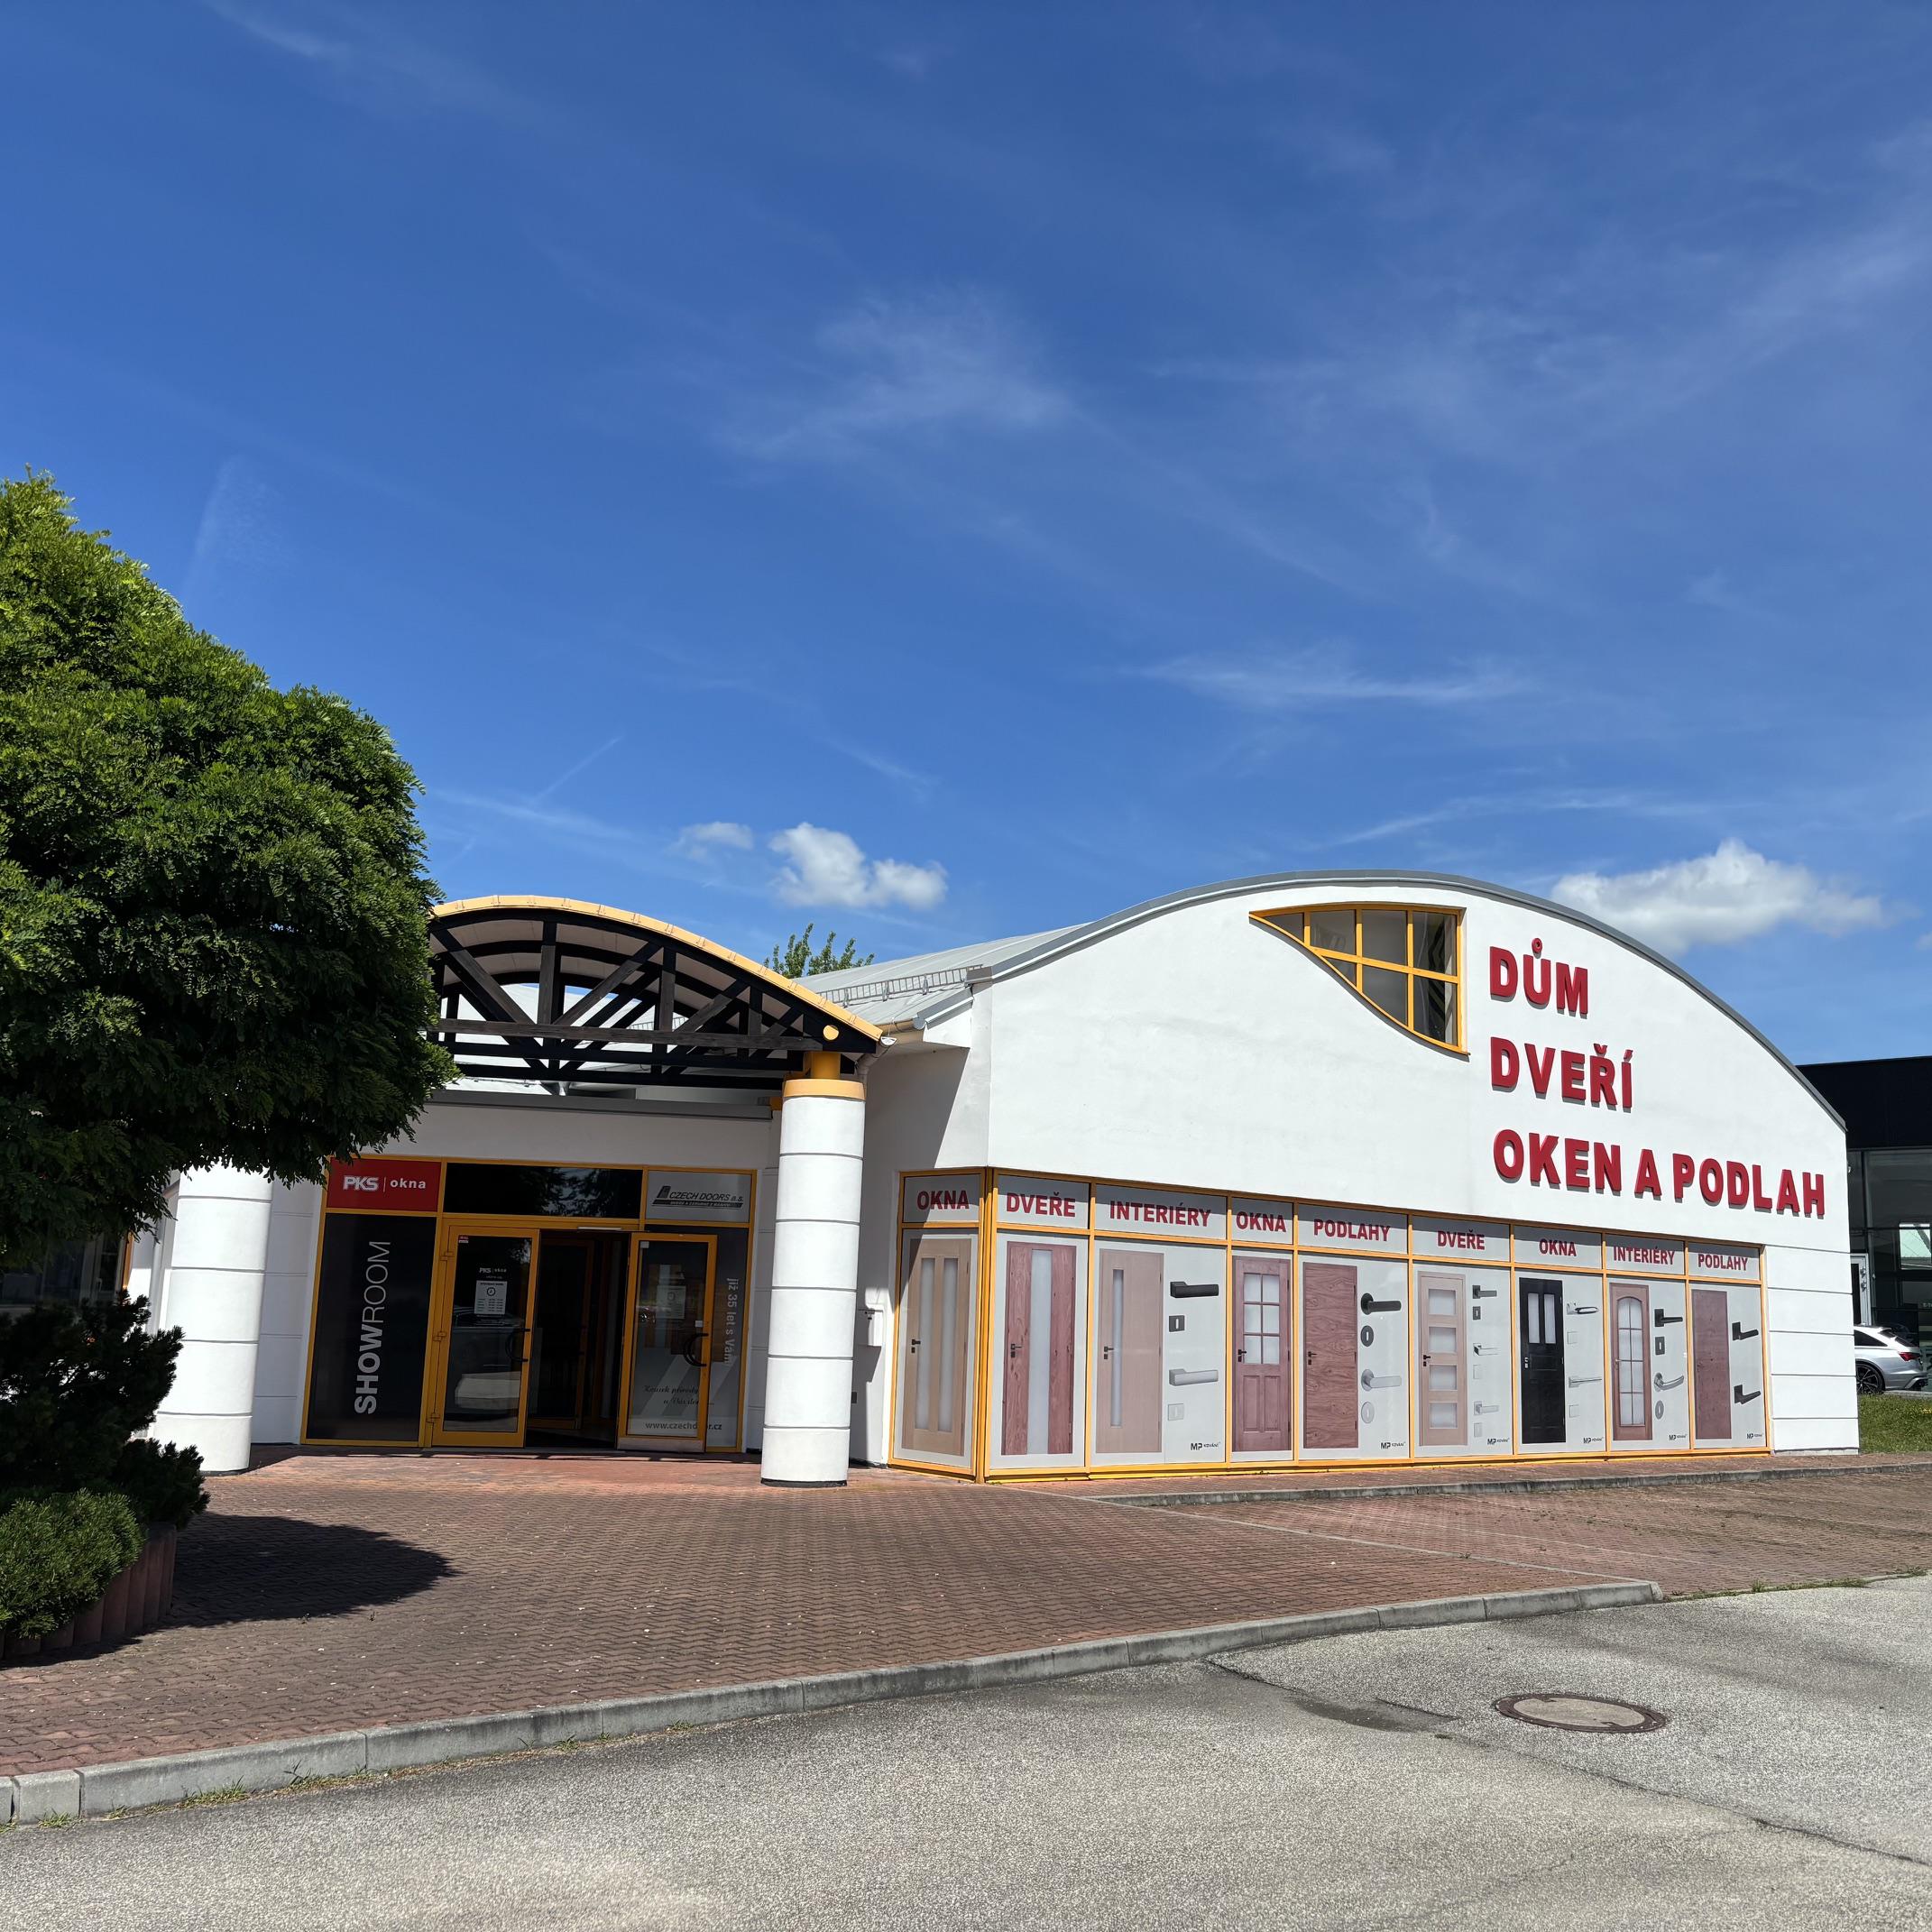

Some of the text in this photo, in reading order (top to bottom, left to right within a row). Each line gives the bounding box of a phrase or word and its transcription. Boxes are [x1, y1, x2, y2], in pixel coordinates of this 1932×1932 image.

[1489, 937, 1588, 1017] DŮM
[1490, 1036, 1633, 1109] DVEŘÍ
[1493, 1129, 1826, 1217] OKEN A PODLAH
[343, 1176, 427, 1191] PKS okna
[668, 1191, 699, 1200] CZECH
[699, 1192, 731, 1201] DOORS
[917, 1190, 970, 1210] OKNA
[1006, 1192, 1076, 1218] DVEŘE
[1109, 1201, 1210, 1228] INTERIÉRY
[1236, 1211, 1286, 1233] OKNA
[1313, 1219, 1391, 1243] PODLAHY
[1437, 1229, 1486, 1251] DVEŘE
[1539, 1238, 1578, 1257] OKNA
[1613, 1245, 1675, 1265] INTERIÉRY
[1697, 1254, 1748, 1271] PODLAHY
[726, 1277, 739, 1291] již
[727, 1294, 738, 1308] 35
[353, 1240, 391, 1415] SHOWROOM
[726, 1311, 737, 1326] let
[645, 1421, 722, 1431] www.czechdr.cz
[1190, 1442, 1203, 1451] MP
[1487, 1438, 1496, 1446] MP
